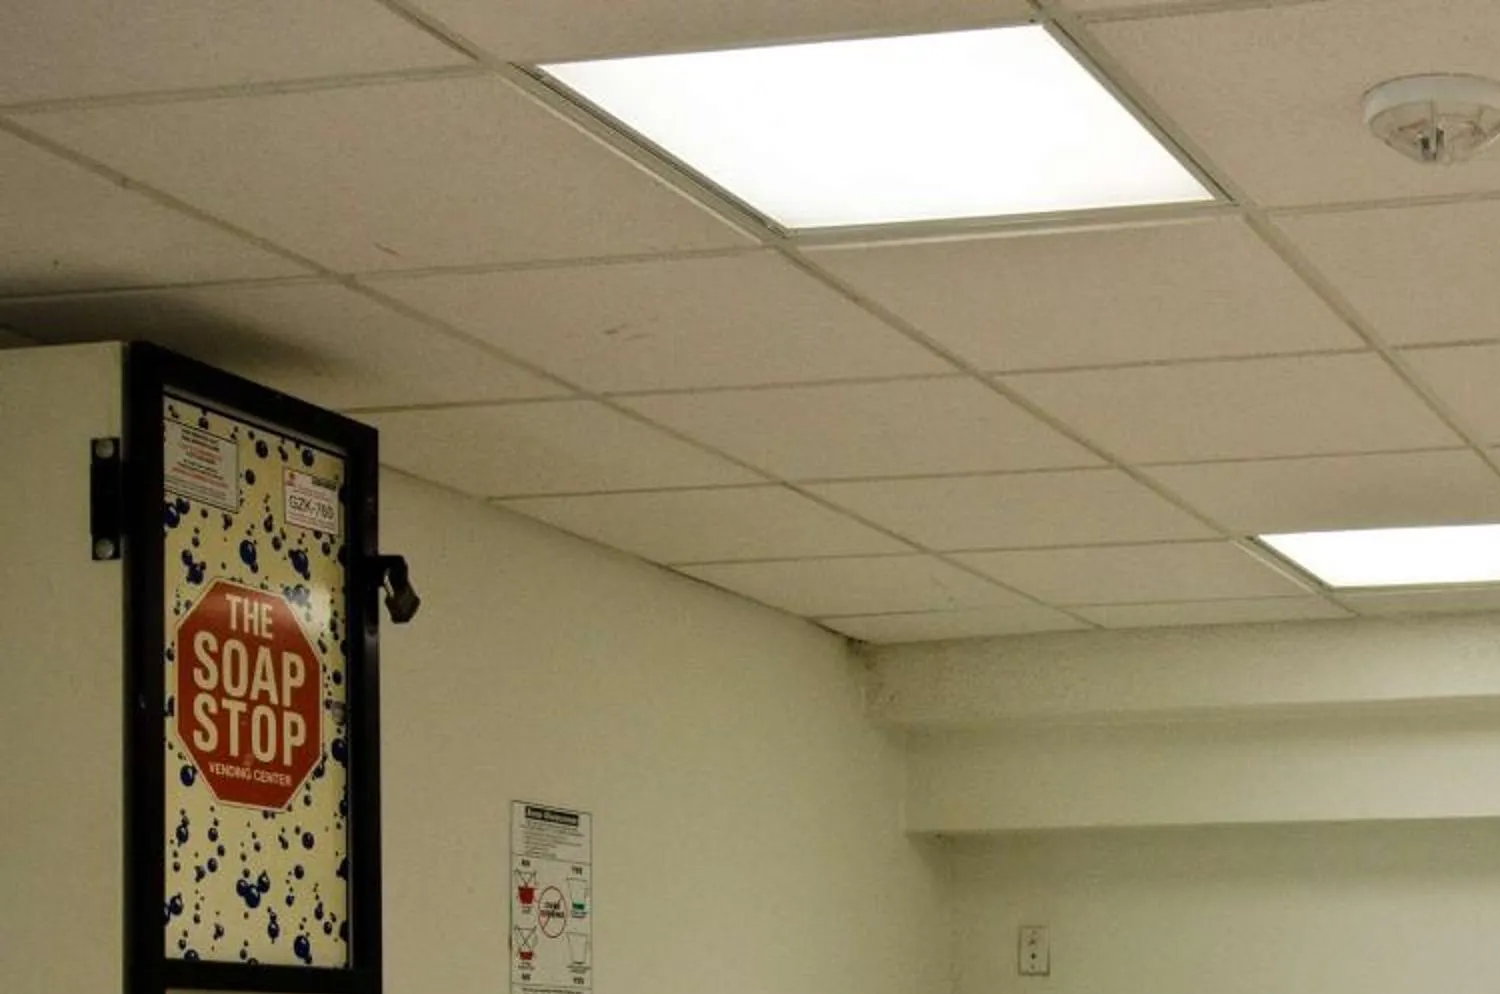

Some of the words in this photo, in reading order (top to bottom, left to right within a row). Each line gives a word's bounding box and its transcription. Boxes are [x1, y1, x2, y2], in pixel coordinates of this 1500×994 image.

[225, 592, 274, 640] THE
[193, 630, 306, 708] SOAP
[193, 692, 307, 767] STOP
[208, 761, 252, 781] VENDING
[253, 768, 293, 788] CENTER
